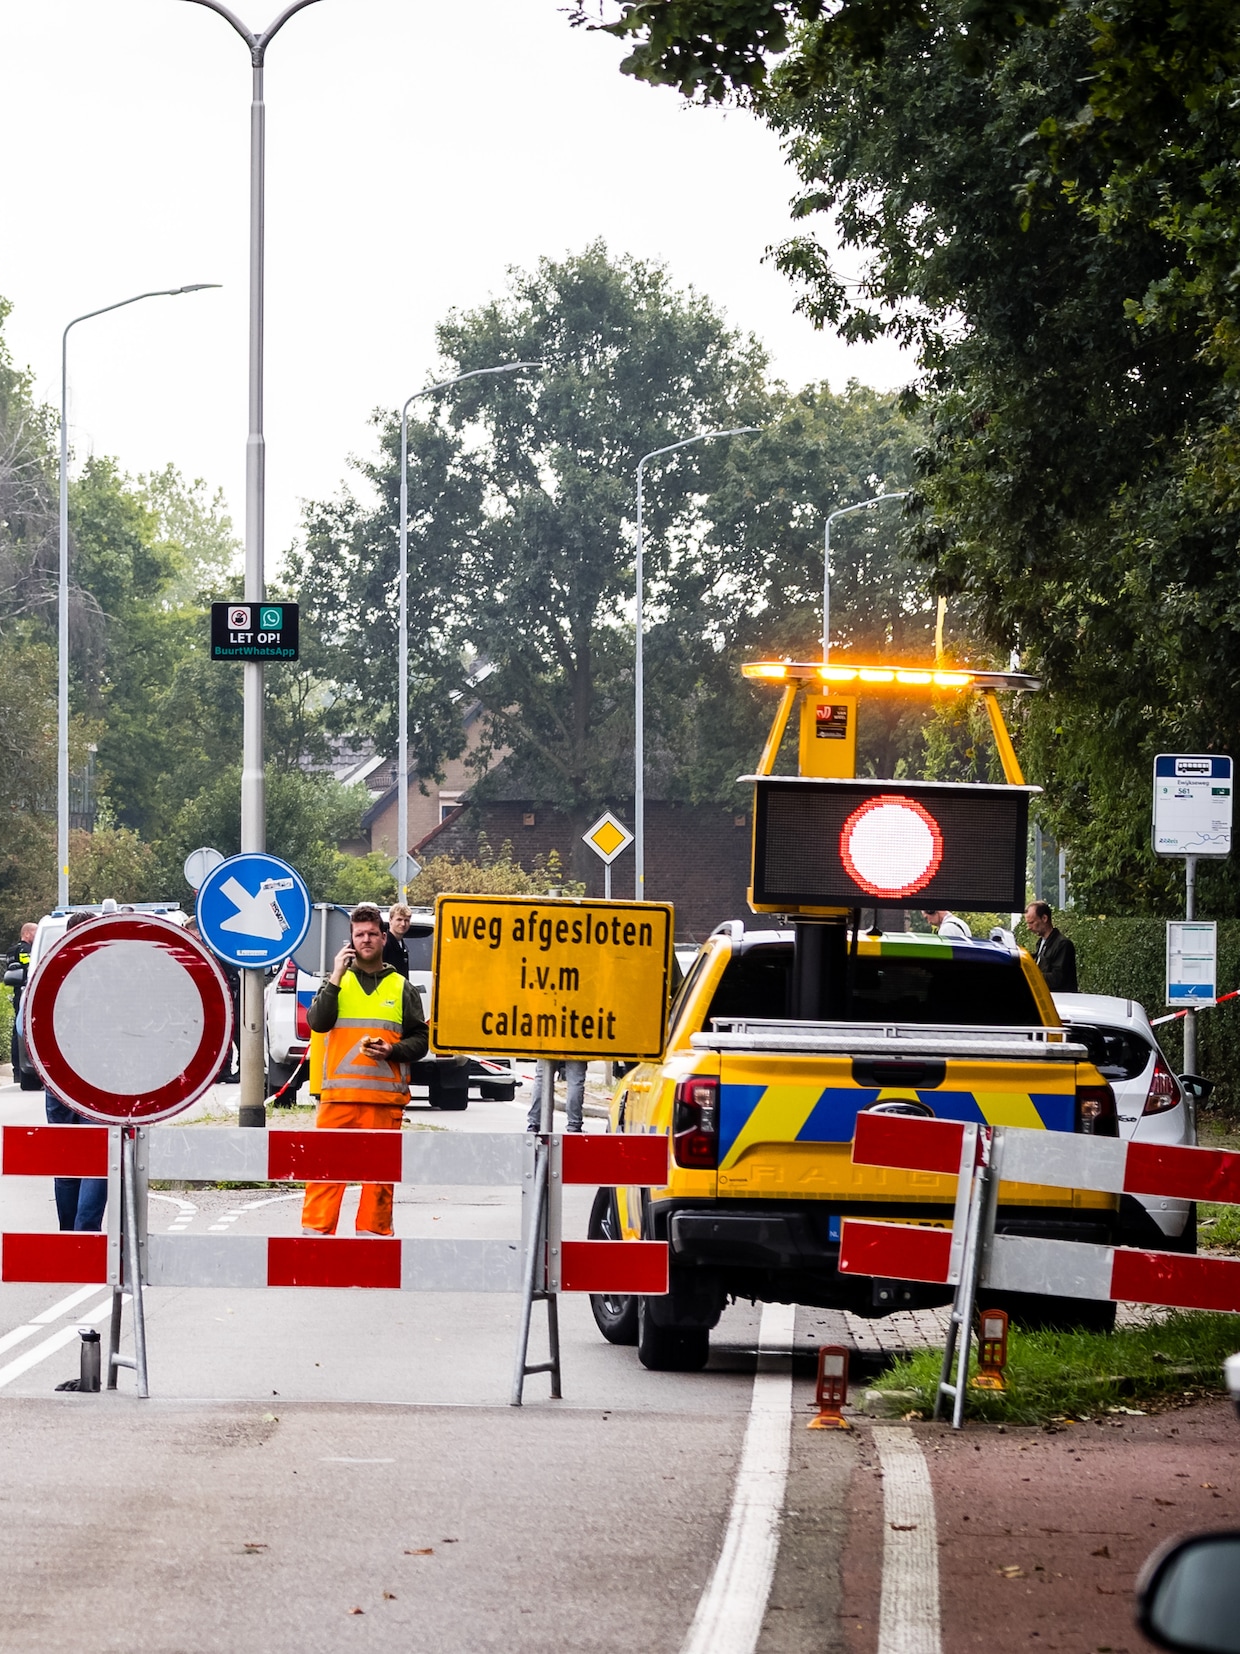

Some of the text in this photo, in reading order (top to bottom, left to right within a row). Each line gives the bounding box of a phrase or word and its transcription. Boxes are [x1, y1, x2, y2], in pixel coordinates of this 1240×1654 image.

[229, 632, 281, 644] LET OP!
[214, 646, 295, 657] BuurtWhatsApp
[1177, 779, 1210, 787] Ewijkseweg
[1178, 787, 1190, 795] 561
[451, 910, 653, 951] weg afgesloten
[520, 957, 580, 991] i.v.m
[481, 1005, 617, 1040] calamiteit
[829, 1230, 839, 1238] NL
